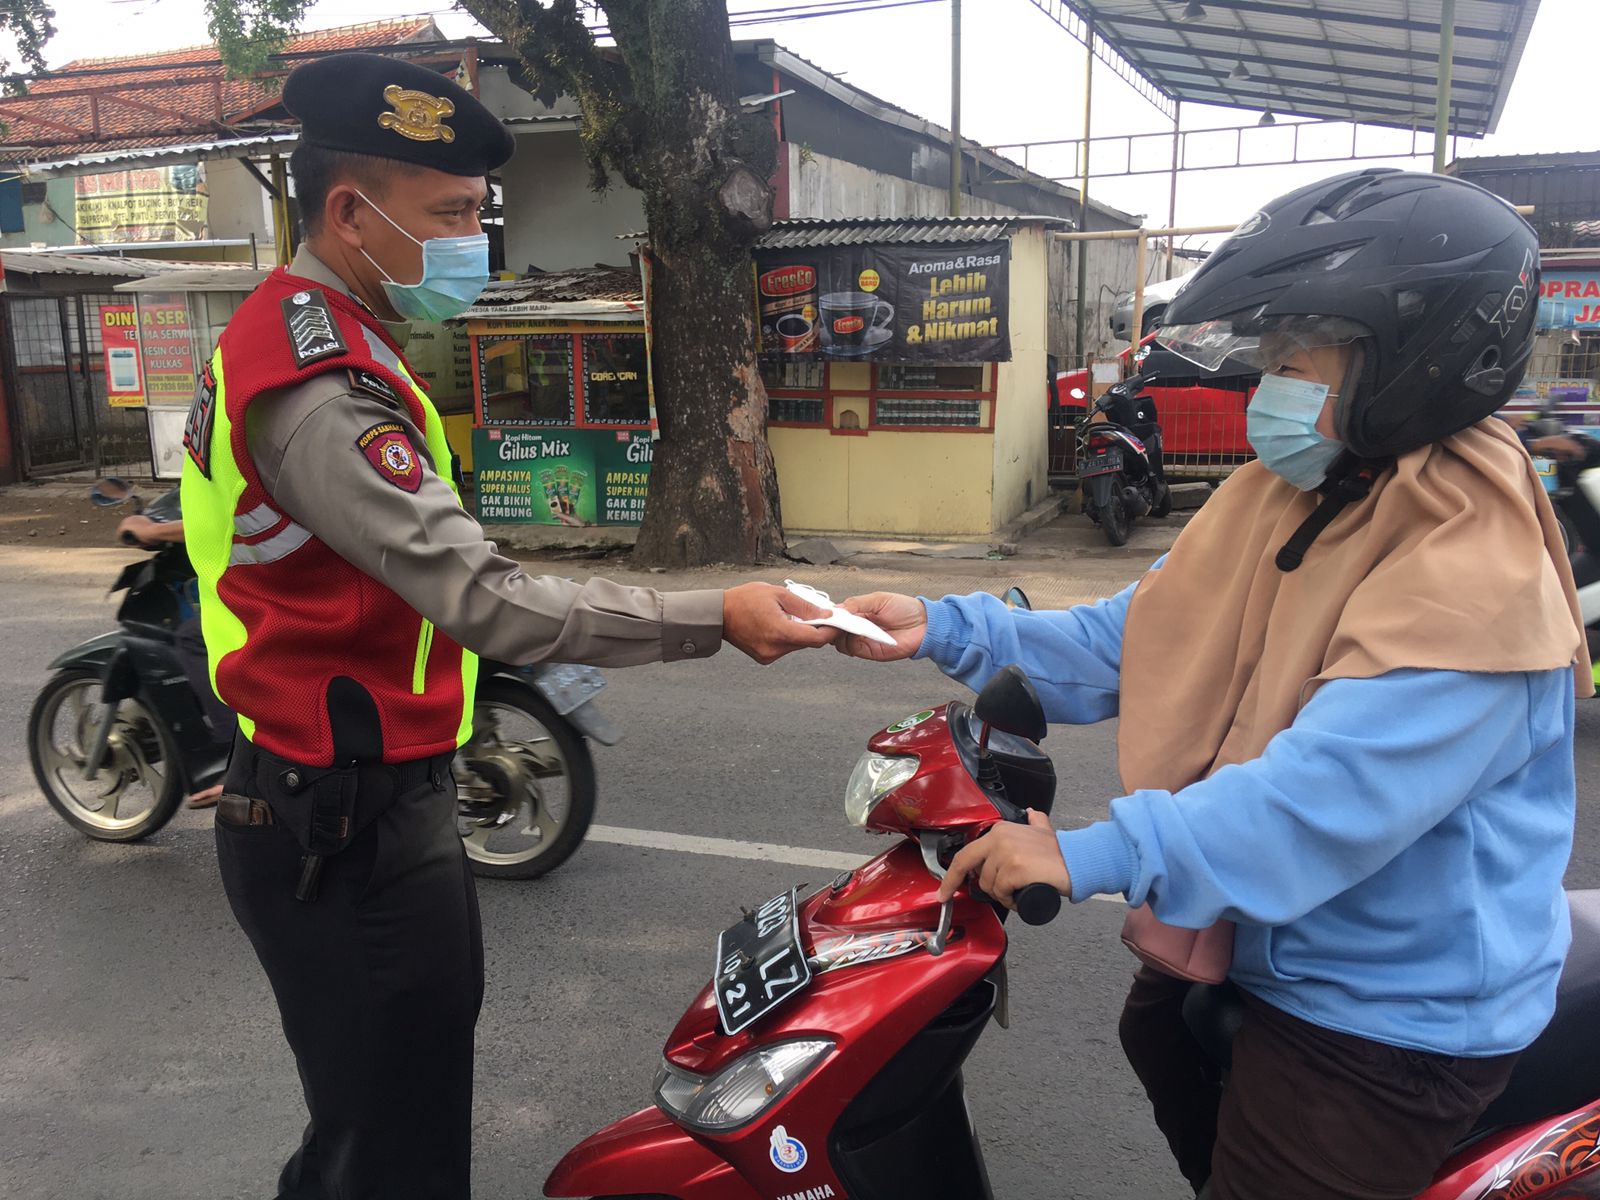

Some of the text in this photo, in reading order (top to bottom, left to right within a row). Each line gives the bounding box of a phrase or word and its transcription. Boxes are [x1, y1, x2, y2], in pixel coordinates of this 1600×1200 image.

[922, 296, 991, 321] Harum
[150, 359, 183, 369] KULKAS
[499, 440, 570, 461] Gilus Mix
[479, 470, 532, 482] AMPASNYA
[606, 472, 648, 484] AMPASN
[480, 484, 531, 494] SUPER HALUS
[606, 487, 631, 497] SUPER
[481, 495, 532, 506] GAK BIKIN
[606, 498, 627, 508] GAK
[482, 507, 532, 518] KEMBUNG
[606, 510, 644, 521] KEMBU
[759, 947, 800, 1000] LZ
[777, 1184, 835, 1200] MAHA
